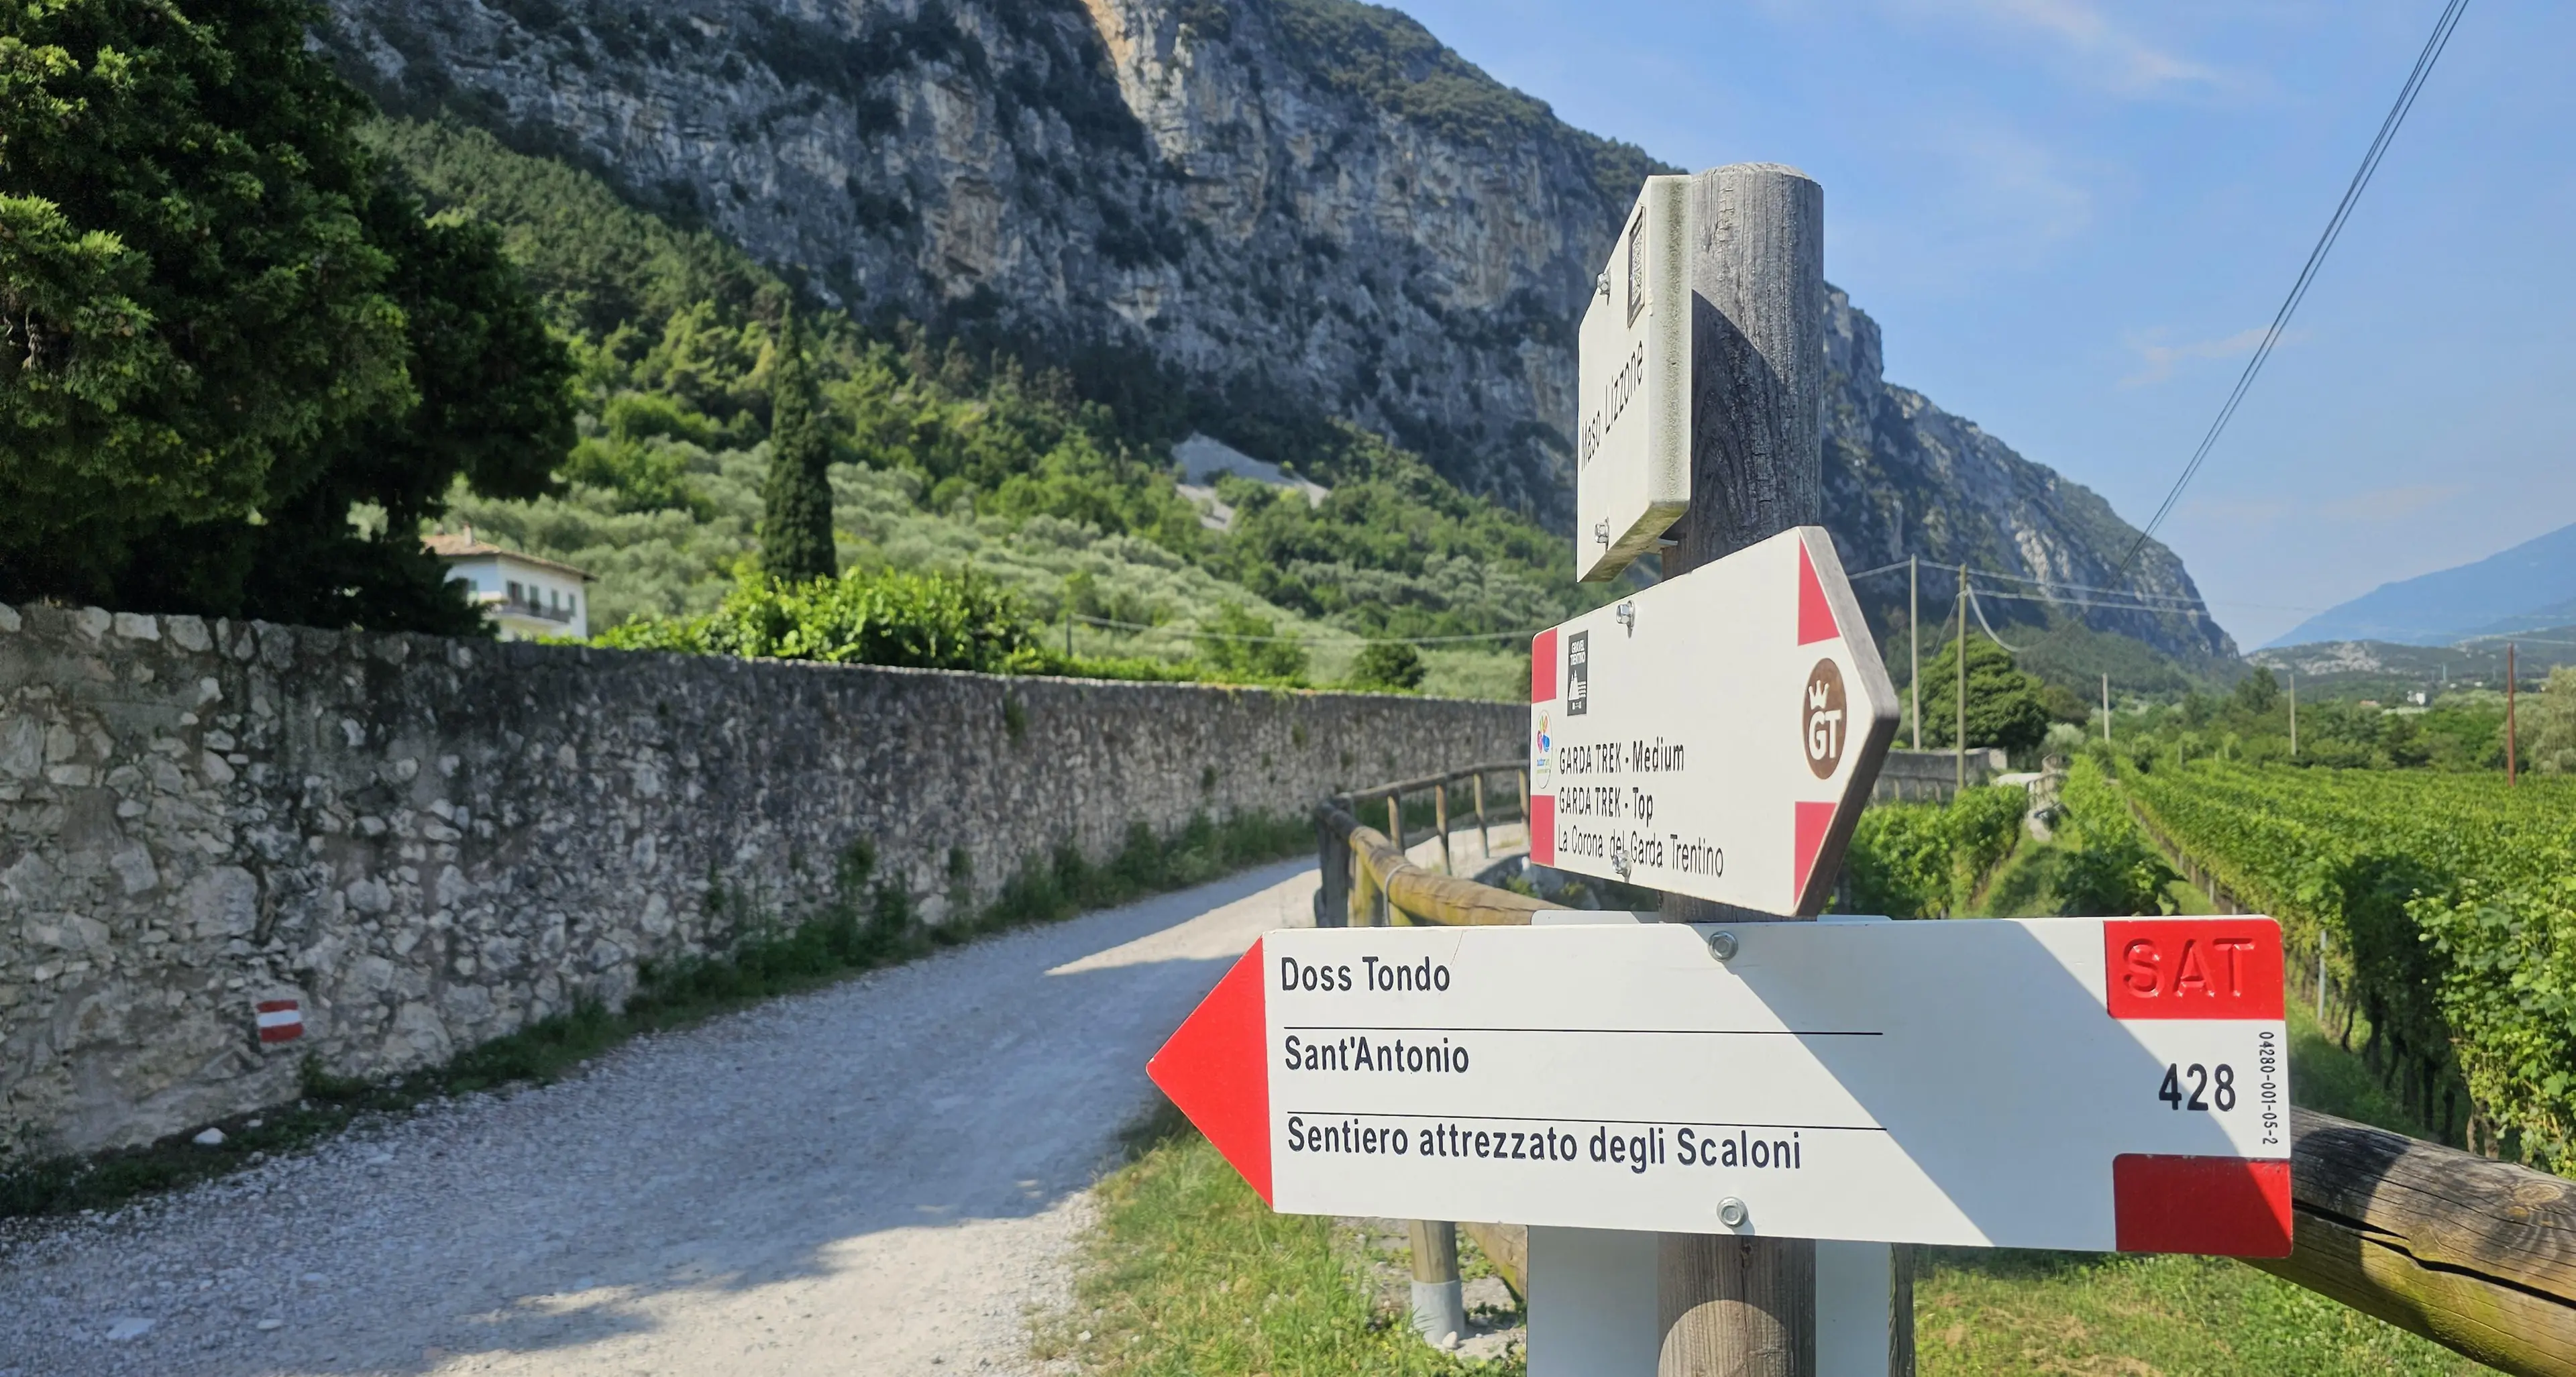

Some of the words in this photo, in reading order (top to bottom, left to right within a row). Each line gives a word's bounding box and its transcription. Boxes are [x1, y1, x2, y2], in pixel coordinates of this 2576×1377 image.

[1581, 410, 1601, 472] Maso
[1605, 340, 1643, 435] Lizzone
[1560, 746, 1592, 775] GARDA
[1596, 742, 1621, 773] TREK
[1633, 736, 1684, 773] Medium
[1809, 710, 1842, 760] GT
[1559, 787, 1591, 816] GARDA
[1595, 787, 1621, 818] TREK
[1633, 787, 1654, 828] Top
[1558, 824, 1568, 852] La
[1572, 824, 1603, 859] Corona
[1610, 828, 1625, 861] del
[1631, 830, 1663, 868] Garda
[1670, 834, 1723, 878] Trentino
[1281, 956, 1352, 991] Doss
[1362, 956, 1450, 991] Tondo
[2123, 938, 2256, 999] SAT
[1285, 1035, 1469, 1073] Sant'Antonio
[2158, 1062, 2236, 1112] 428
[2259, 1031, 2278, 1145] 04280-001-05-2
[1287, 1116, 1408, 1155] Sentiero
[1419, 1123, 1577, 1162] attrezzato
[1589, 1125, 1665, 1174] degli
[1677, 1127, 1801, 1169] Scaloni
